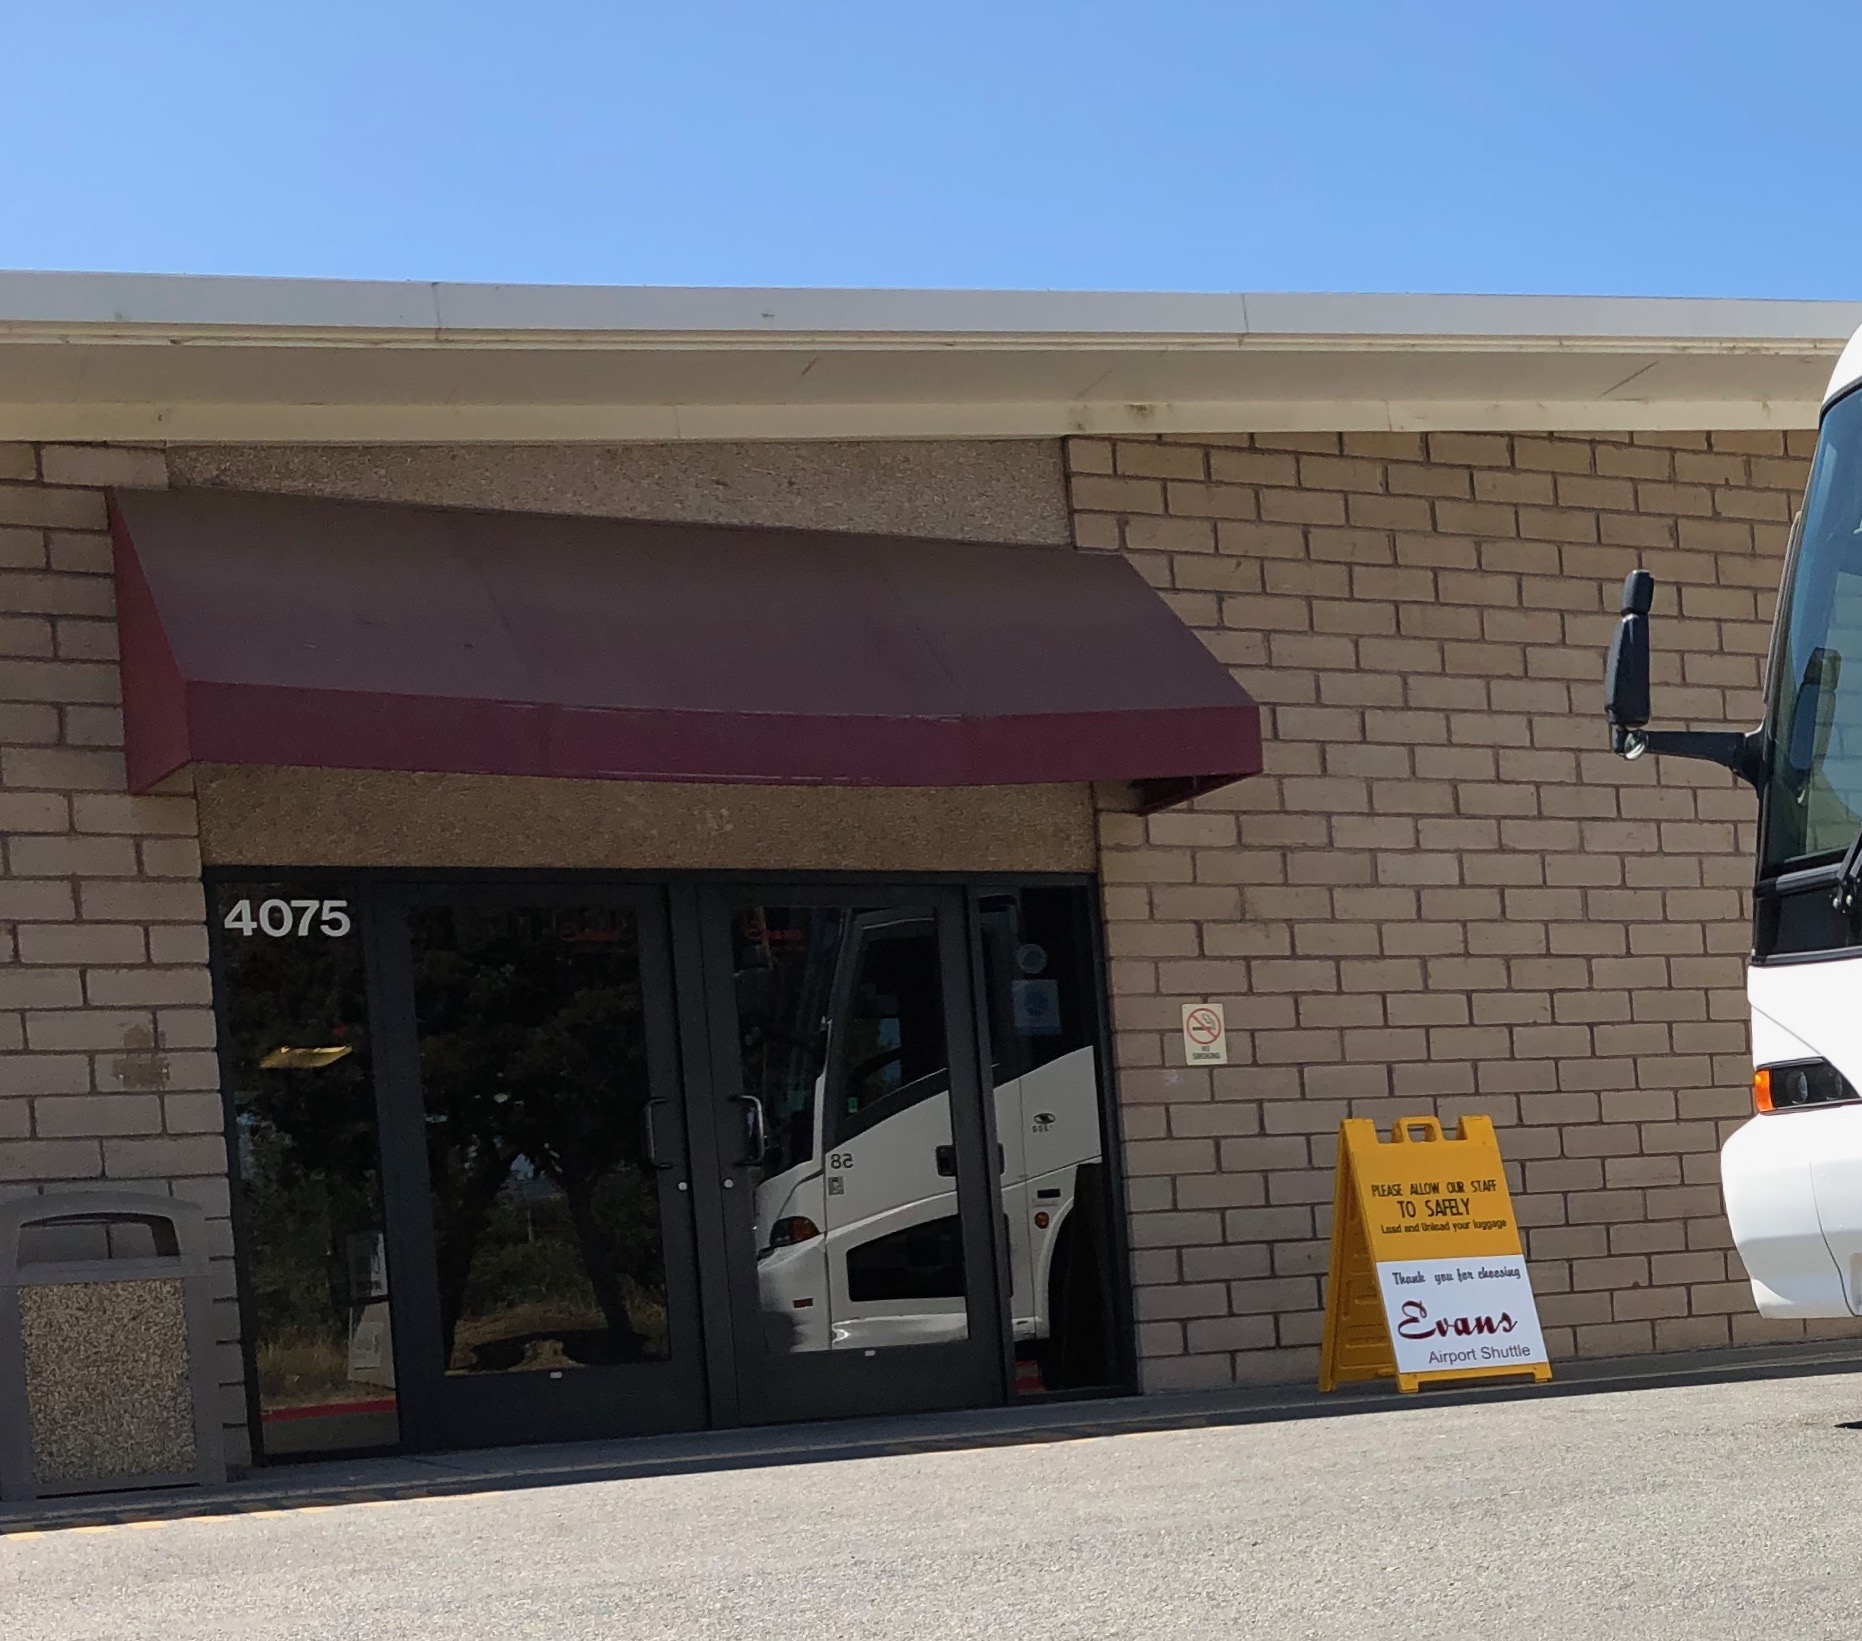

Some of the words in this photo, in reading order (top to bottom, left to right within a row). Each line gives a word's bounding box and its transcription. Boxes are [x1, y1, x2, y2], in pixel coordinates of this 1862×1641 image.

[224, 898, 350, 937] 4075
[1371, 1183, 1403, 1197] PLEASE
[1410, 1182, 1440, 1195] ALLOW
[1446, 1181, 1465, 1194] OUR
[1470, 1179, 1497, 1193] STAFF
[1396, 1200, 1416, 1218] TO
[1425, 1198, 1470, 1217] SAFELY
[1381, 1224, 1402, 1234] Load
[1404, 1223, 1420, 1233] and
[1453, 1221, 1470, 1232] your
[1473, 1219, 1507, 1230] luggage
[1392, 1271, 1426, 1285] Thank
[1434, 1272, 1454, 1285] you
[1457, 1268, 1474, 1282] for
[1478, 1266, 1521, 1280] choosing
[1398, 1300, 1518, 1340] Evans
[1428, 1348, 1477, 1365] Airport
[1480, 1344, 1531, 1360] Shuttle
